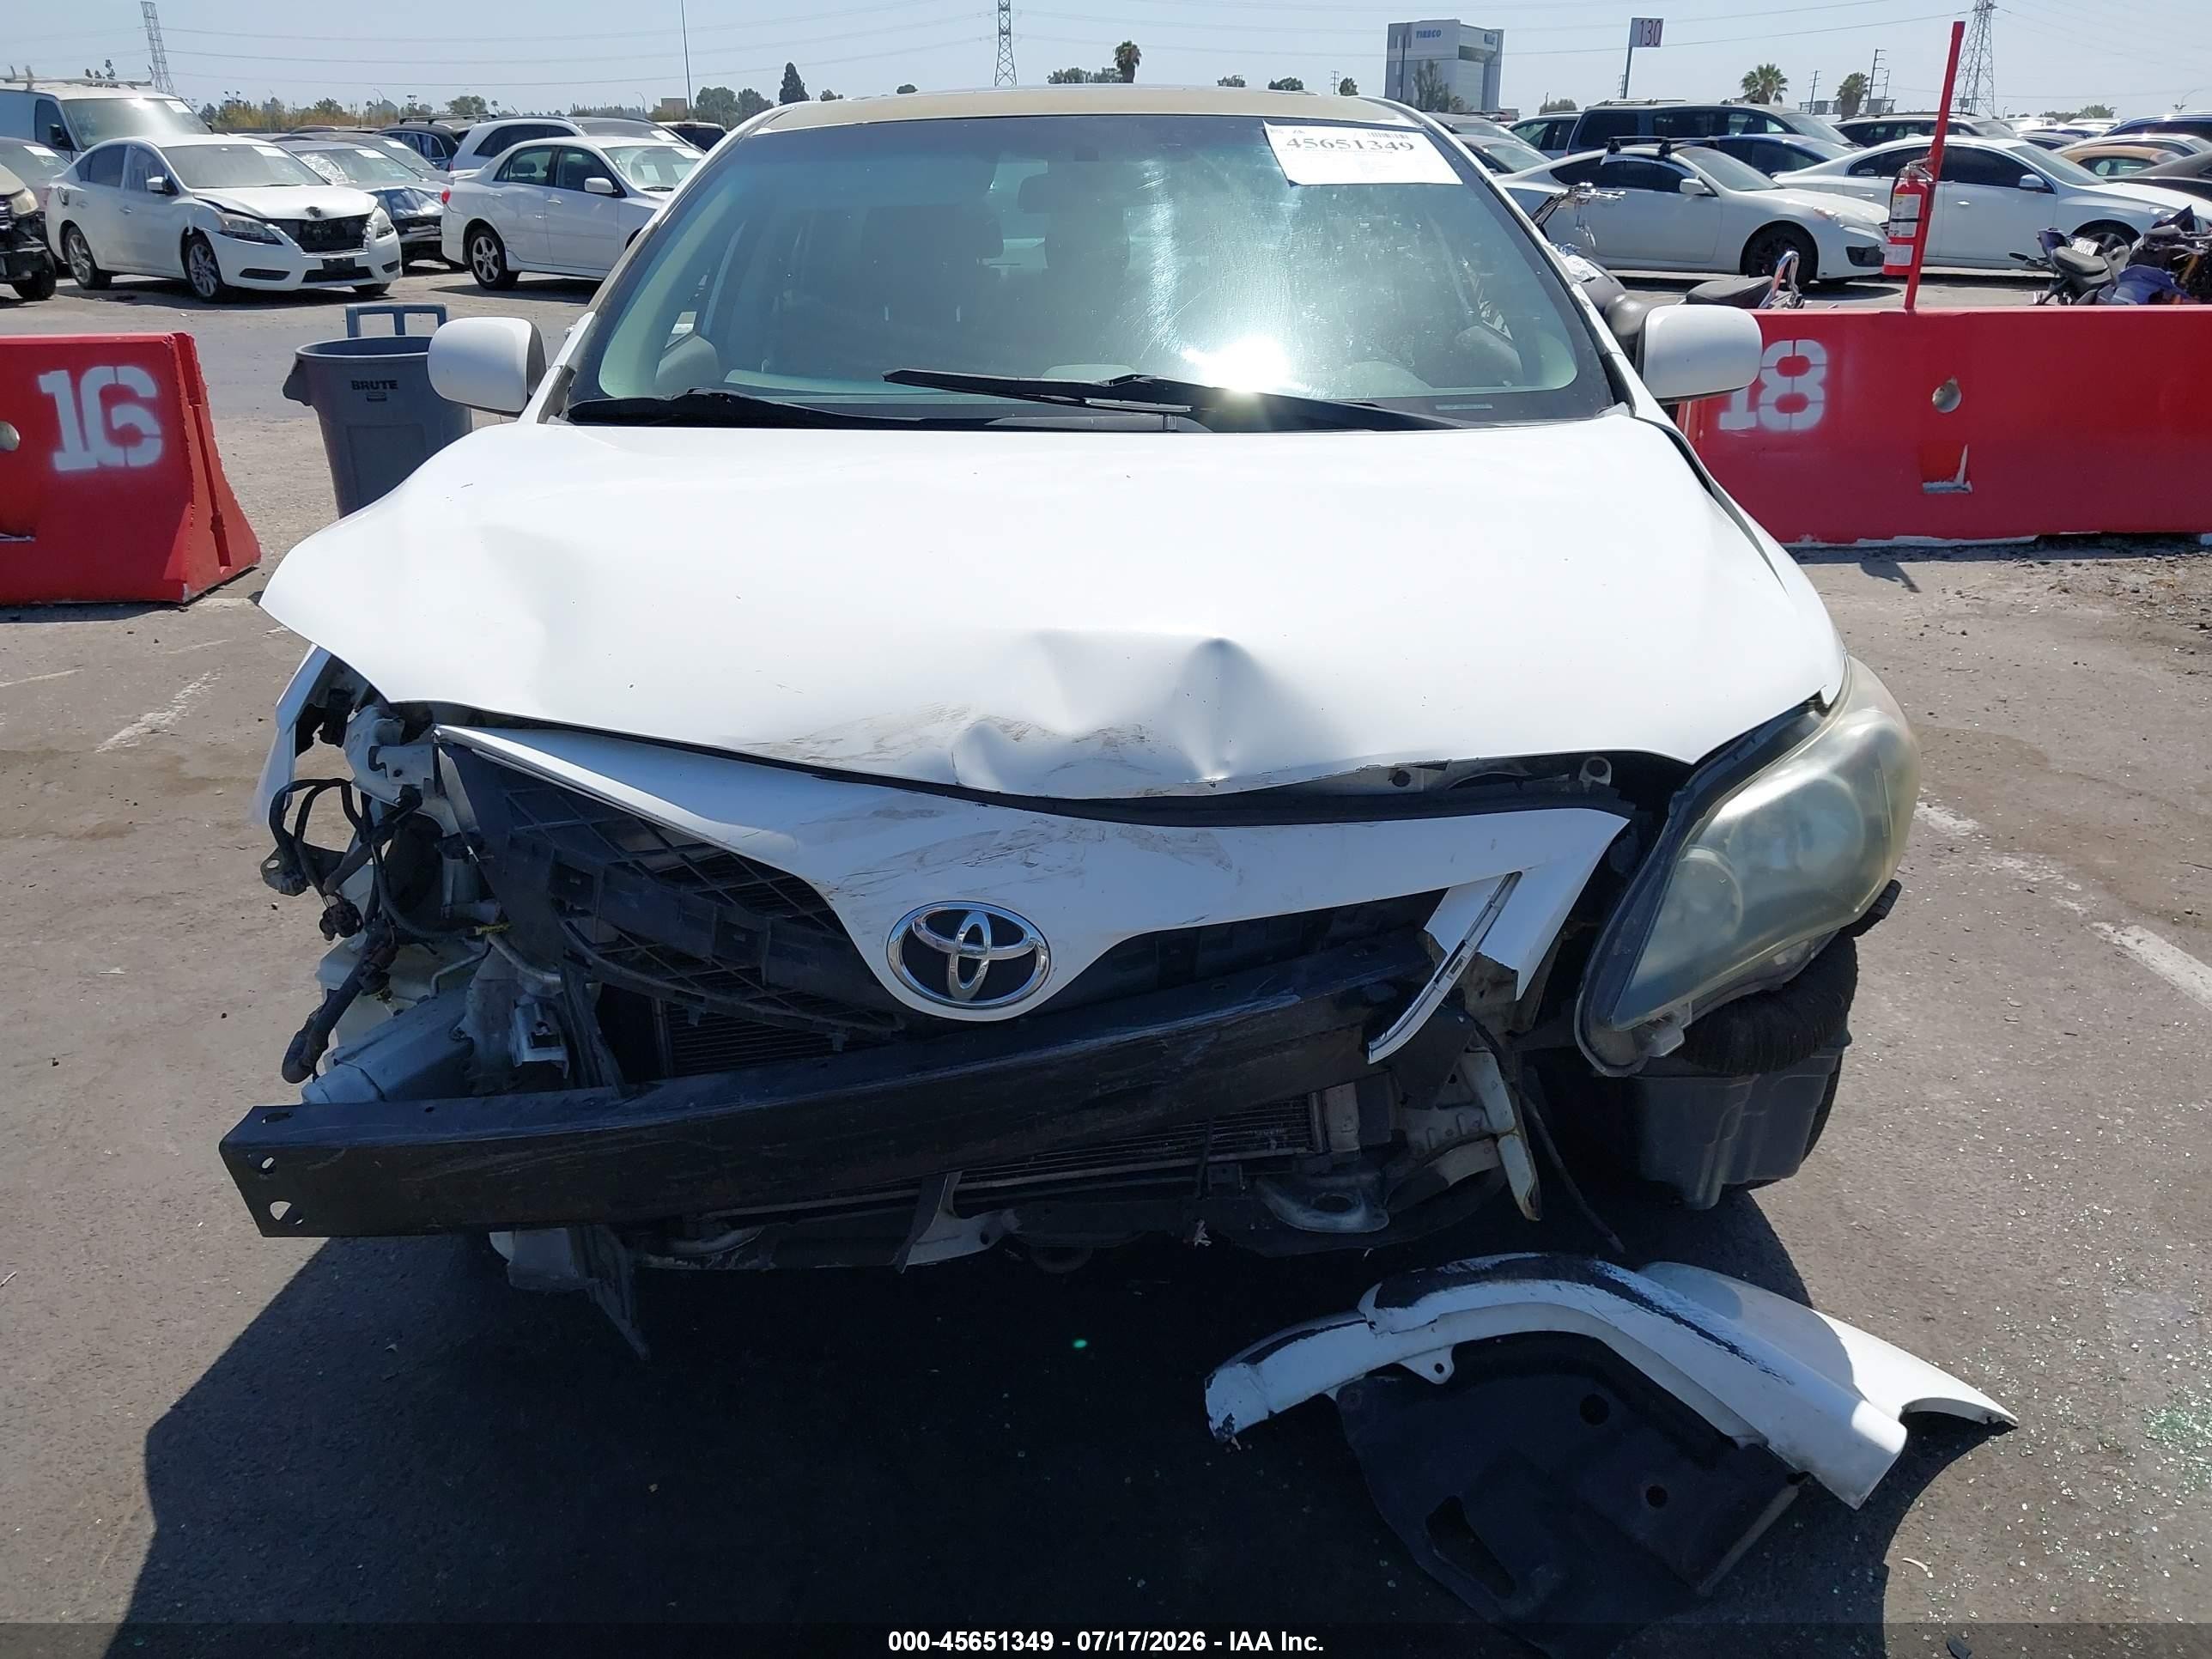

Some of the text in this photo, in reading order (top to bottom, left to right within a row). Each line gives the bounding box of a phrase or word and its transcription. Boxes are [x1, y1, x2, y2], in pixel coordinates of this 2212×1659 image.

[1640, 20, 1662, 46] 130
[1286, 137, 1414, 151] 45651349
[350, 380, 398, 391] BRUTE
[38, 366, 162, 471] 16
